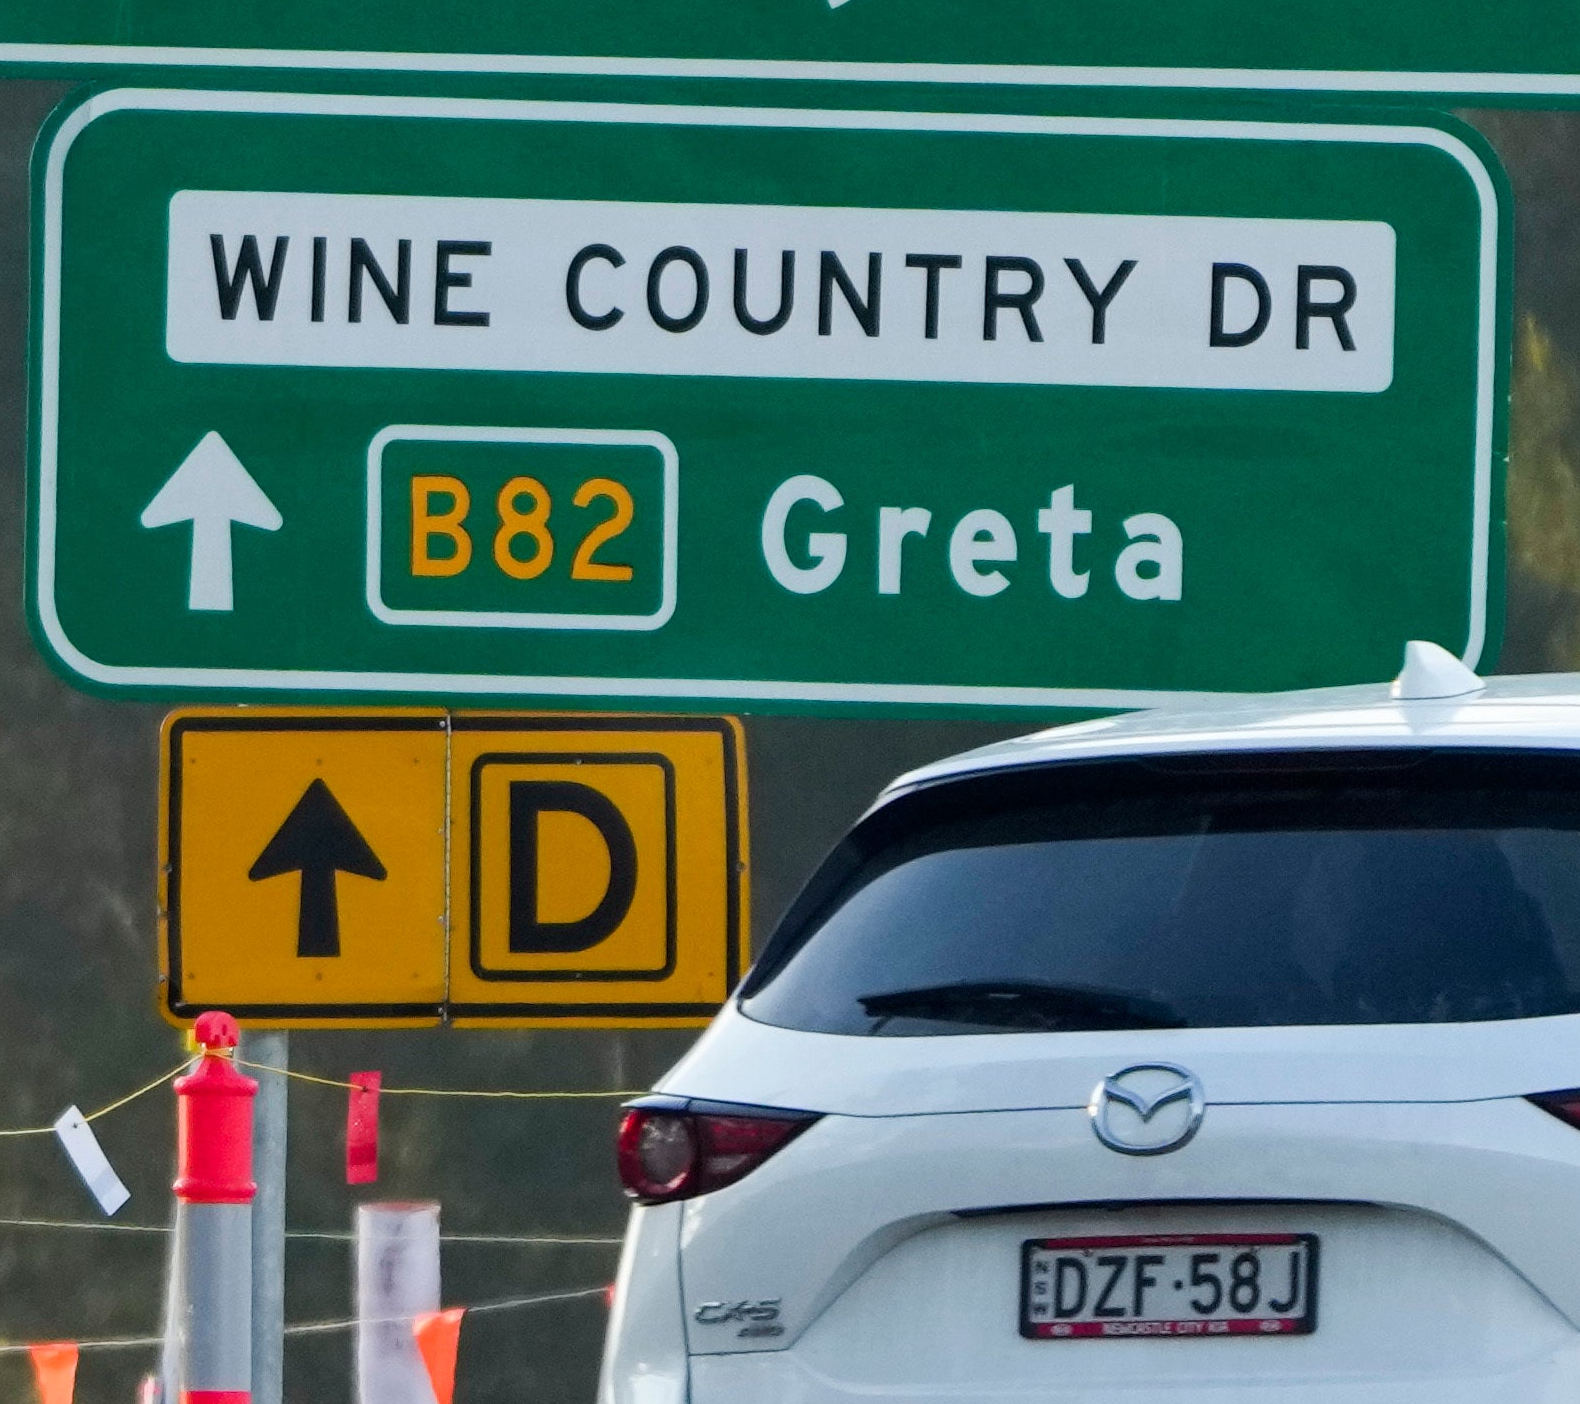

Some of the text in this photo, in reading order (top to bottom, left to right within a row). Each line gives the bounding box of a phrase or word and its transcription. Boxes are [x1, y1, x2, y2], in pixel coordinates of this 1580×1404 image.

[208, 233, 1358, 353] WINE COUNTRY DR
[410, 474, 1184, 602] B82 Greta
[507, 779, 639, 955] D
